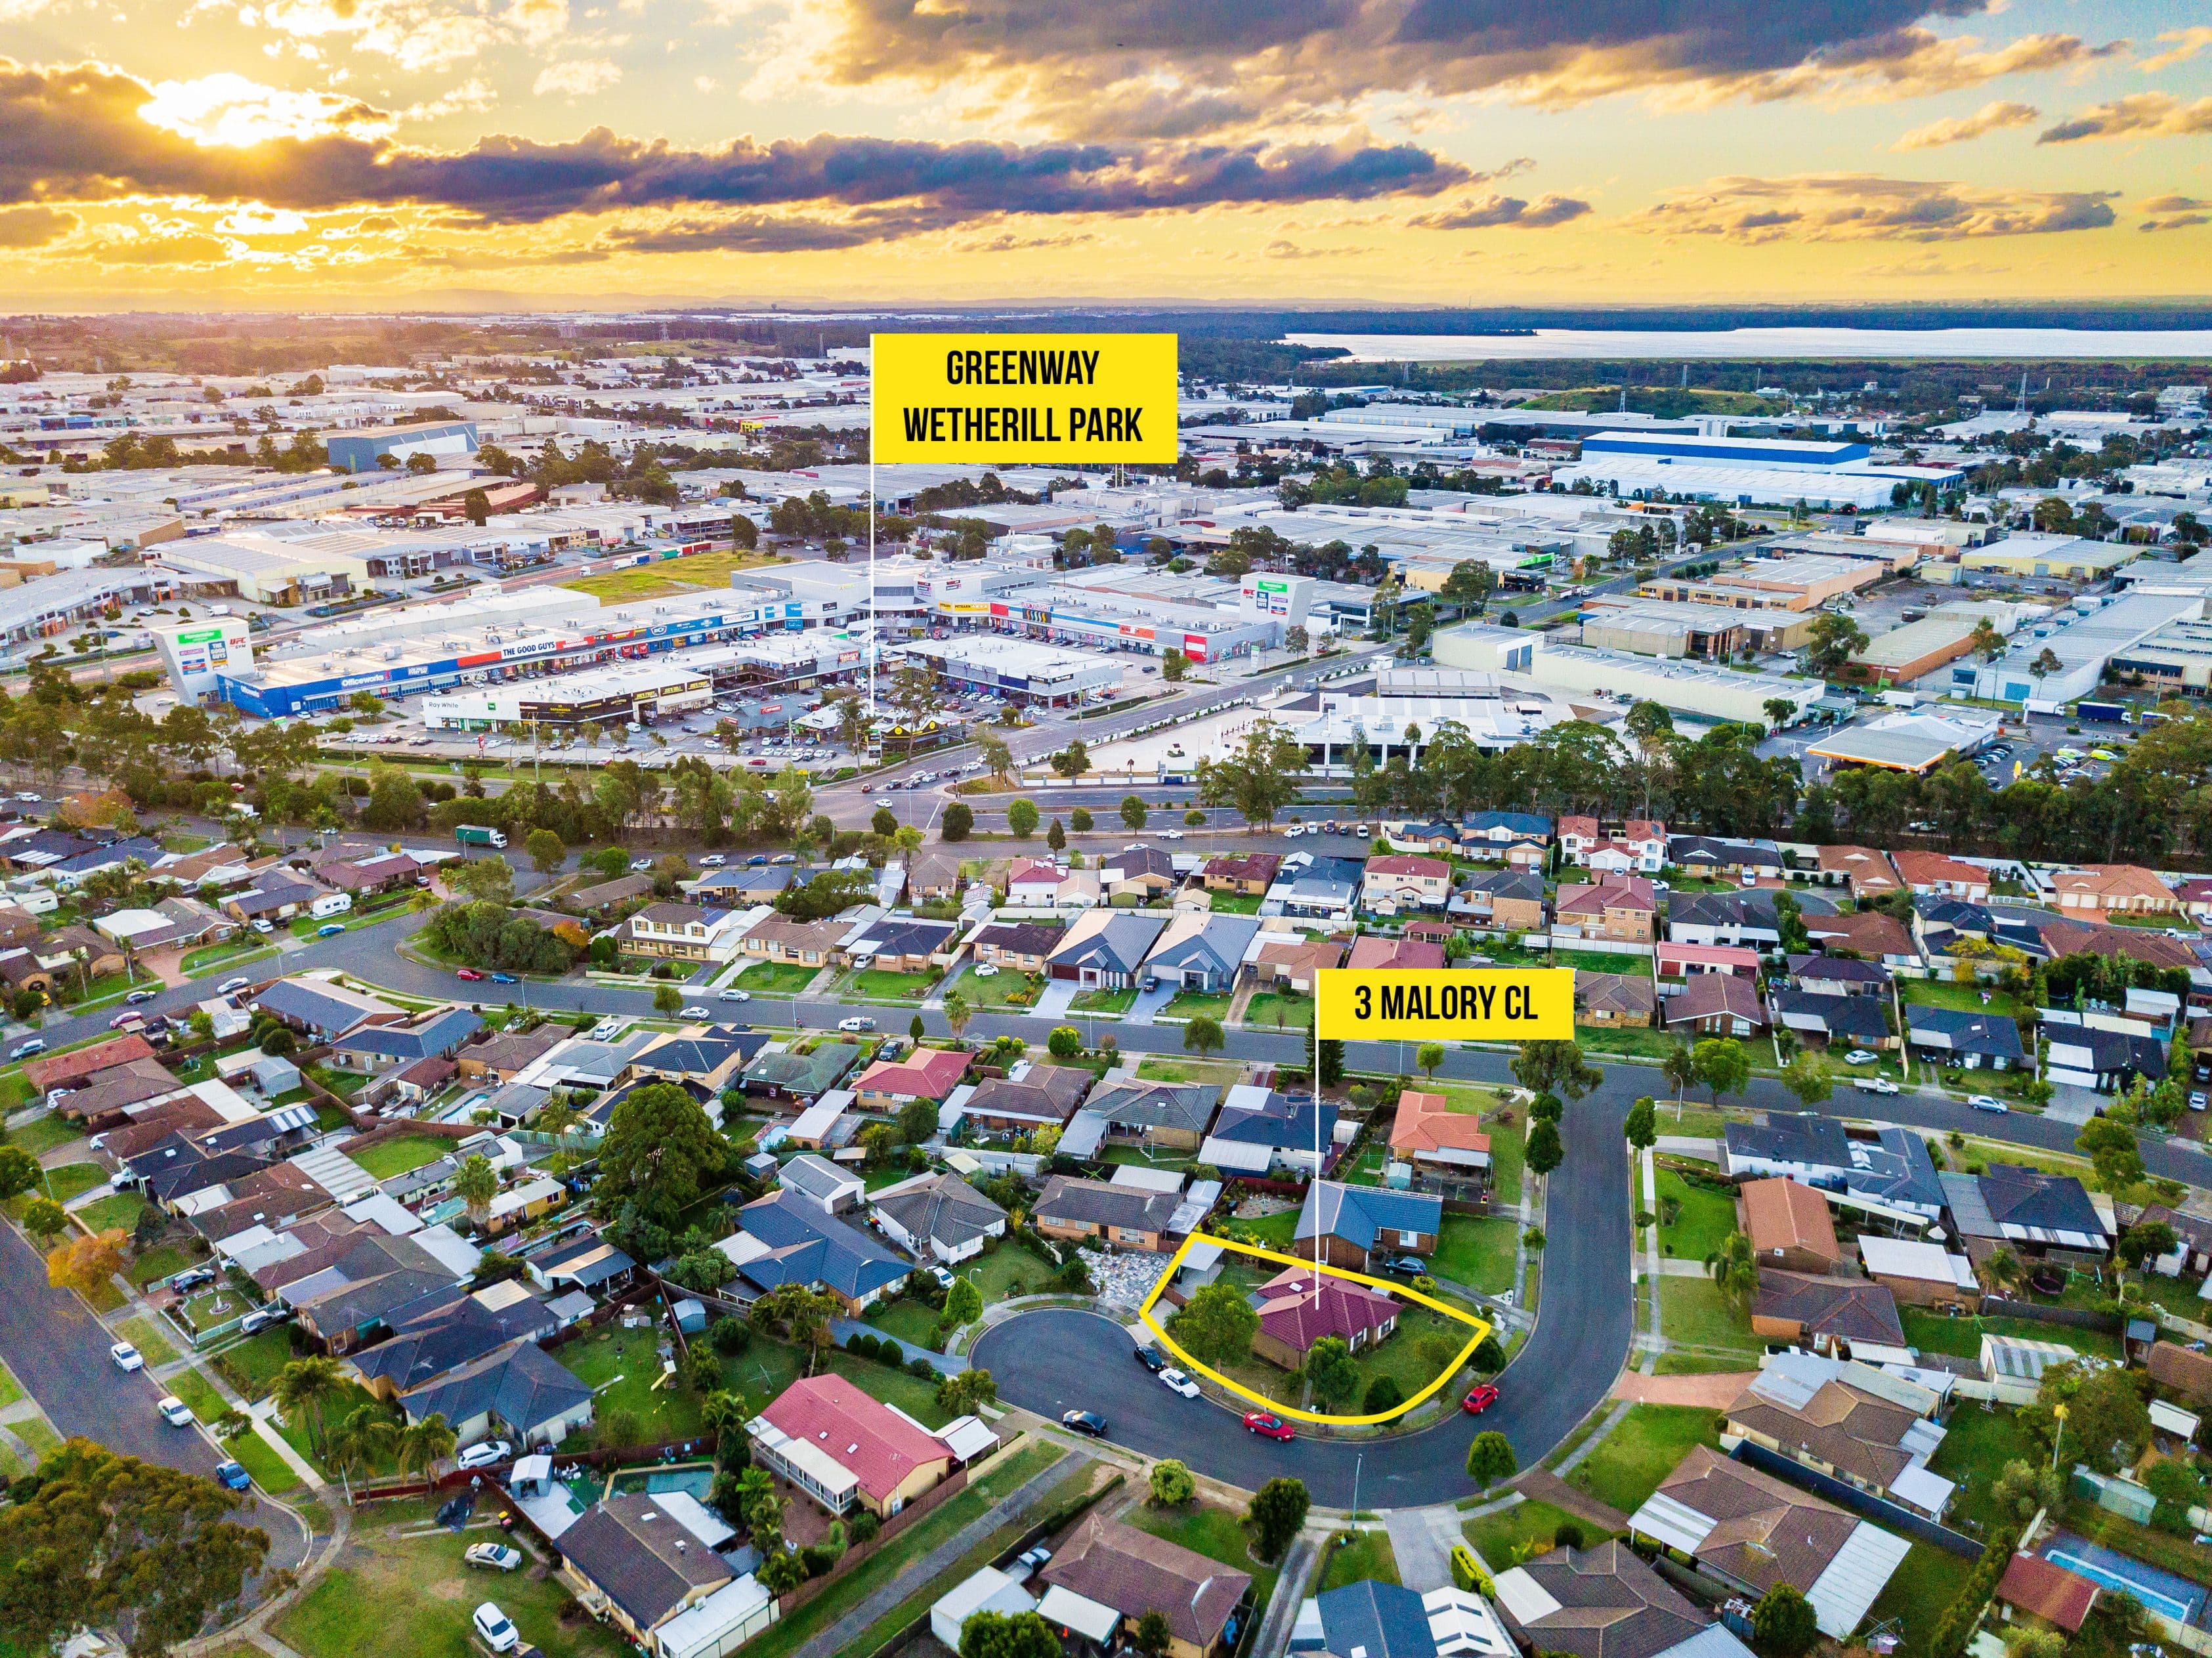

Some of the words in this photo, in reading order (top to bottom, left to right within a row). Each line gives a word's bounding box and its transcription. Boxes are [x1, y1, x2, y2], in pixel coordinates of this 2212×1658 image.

[728, 613, 753, 622] INTERSPORT
[517, 645, 536, 654] GOOD
[538, 641, 555, 650] GUYS
[342, 674, 385, 687] Officeworks
